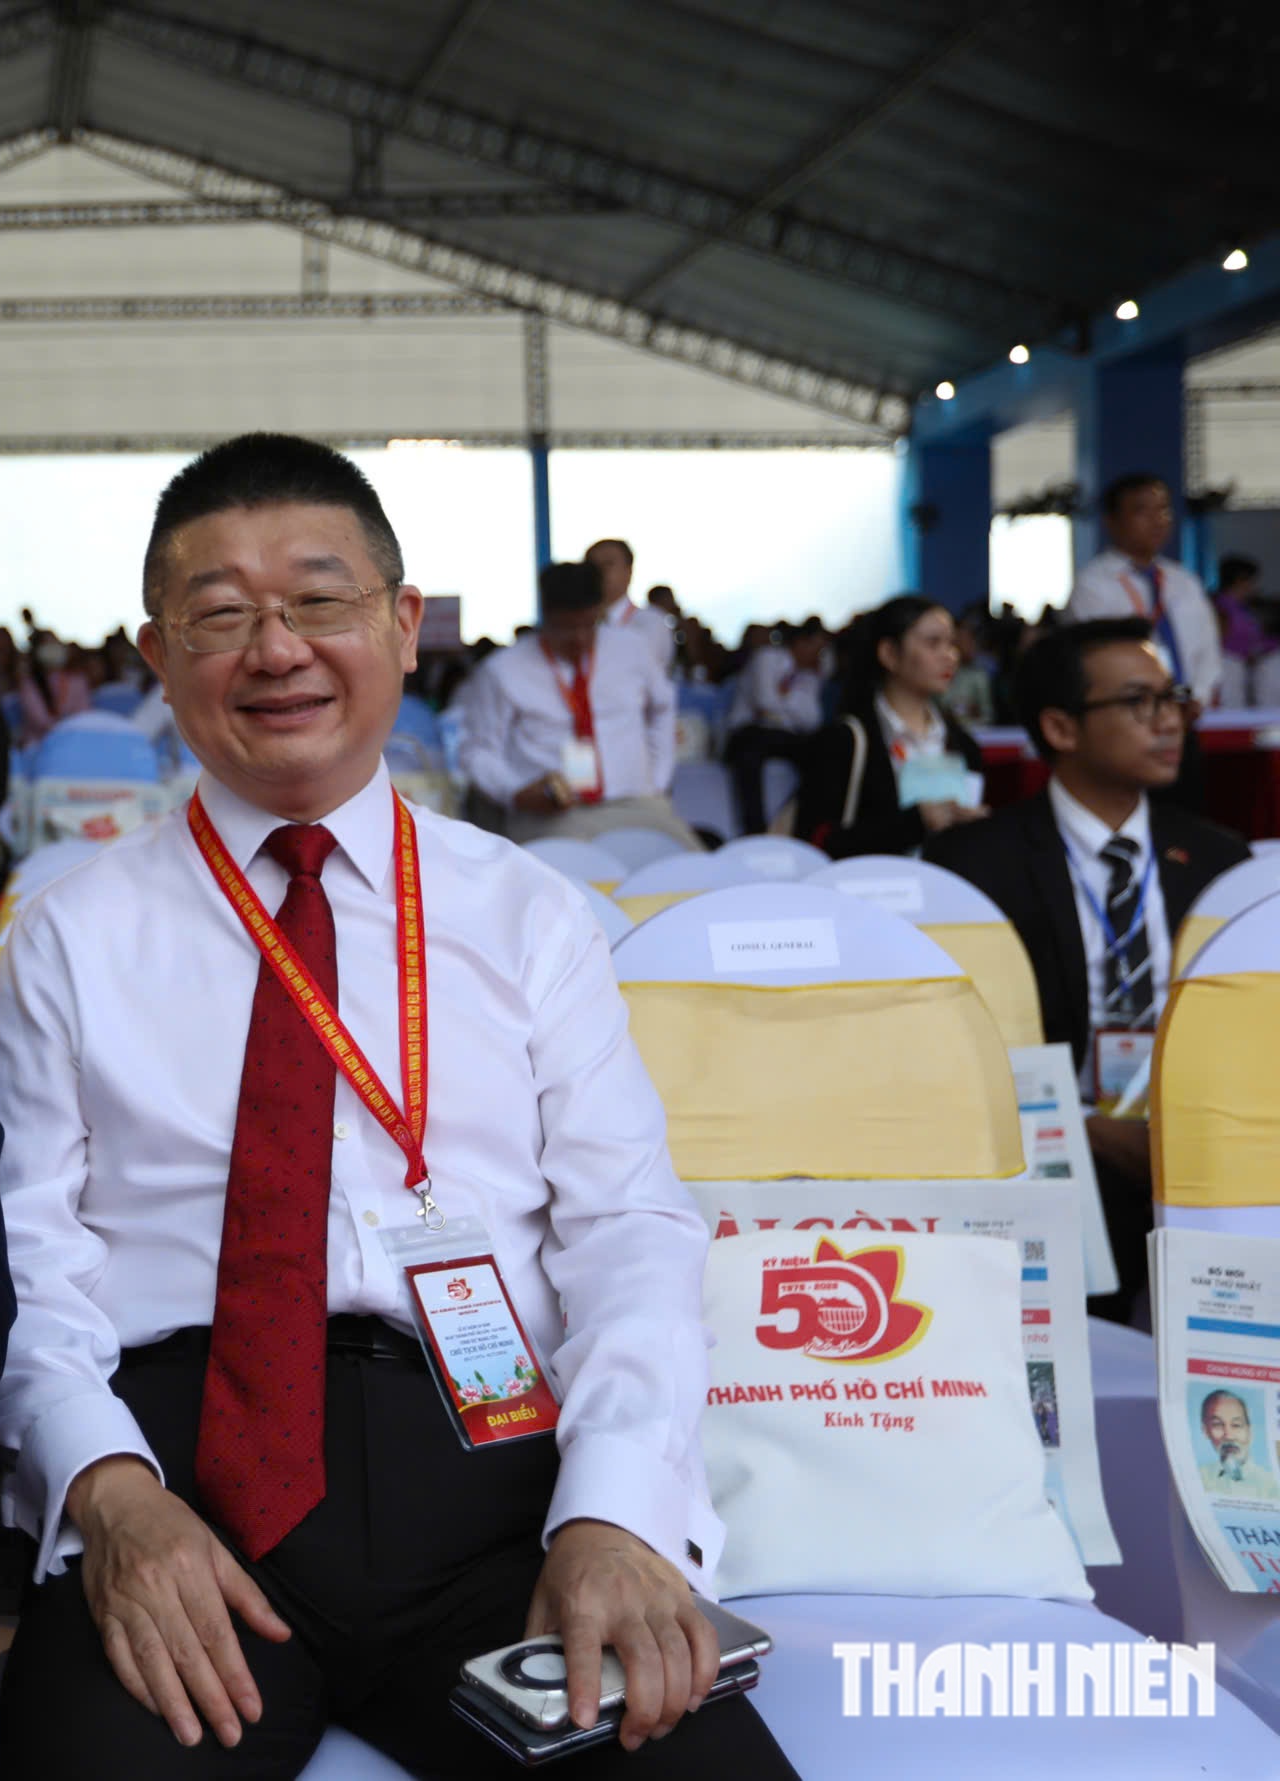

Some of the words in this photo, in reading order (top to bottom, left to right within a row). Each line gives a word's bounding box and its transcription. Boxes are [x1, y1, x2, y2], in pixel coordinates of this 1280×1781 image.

[755, 1266, 882, 1360] 50
[707, 1382, 784, 1406] THÀNH
[790, 1379, 837, 1401] PHỐ
[844, 1377, 877, 1401] HỒ
[884, 1376, 925, 1400] CHÍ
[931, 1380, 987, 1398] MINH
[487, 1412, 509, 1427] ĐẠI
[509, 1403, 537, 1422] BIỂU
[824, 1411, 864, 1428] Kính
[870, 1412, 915, 1432] Tặng
